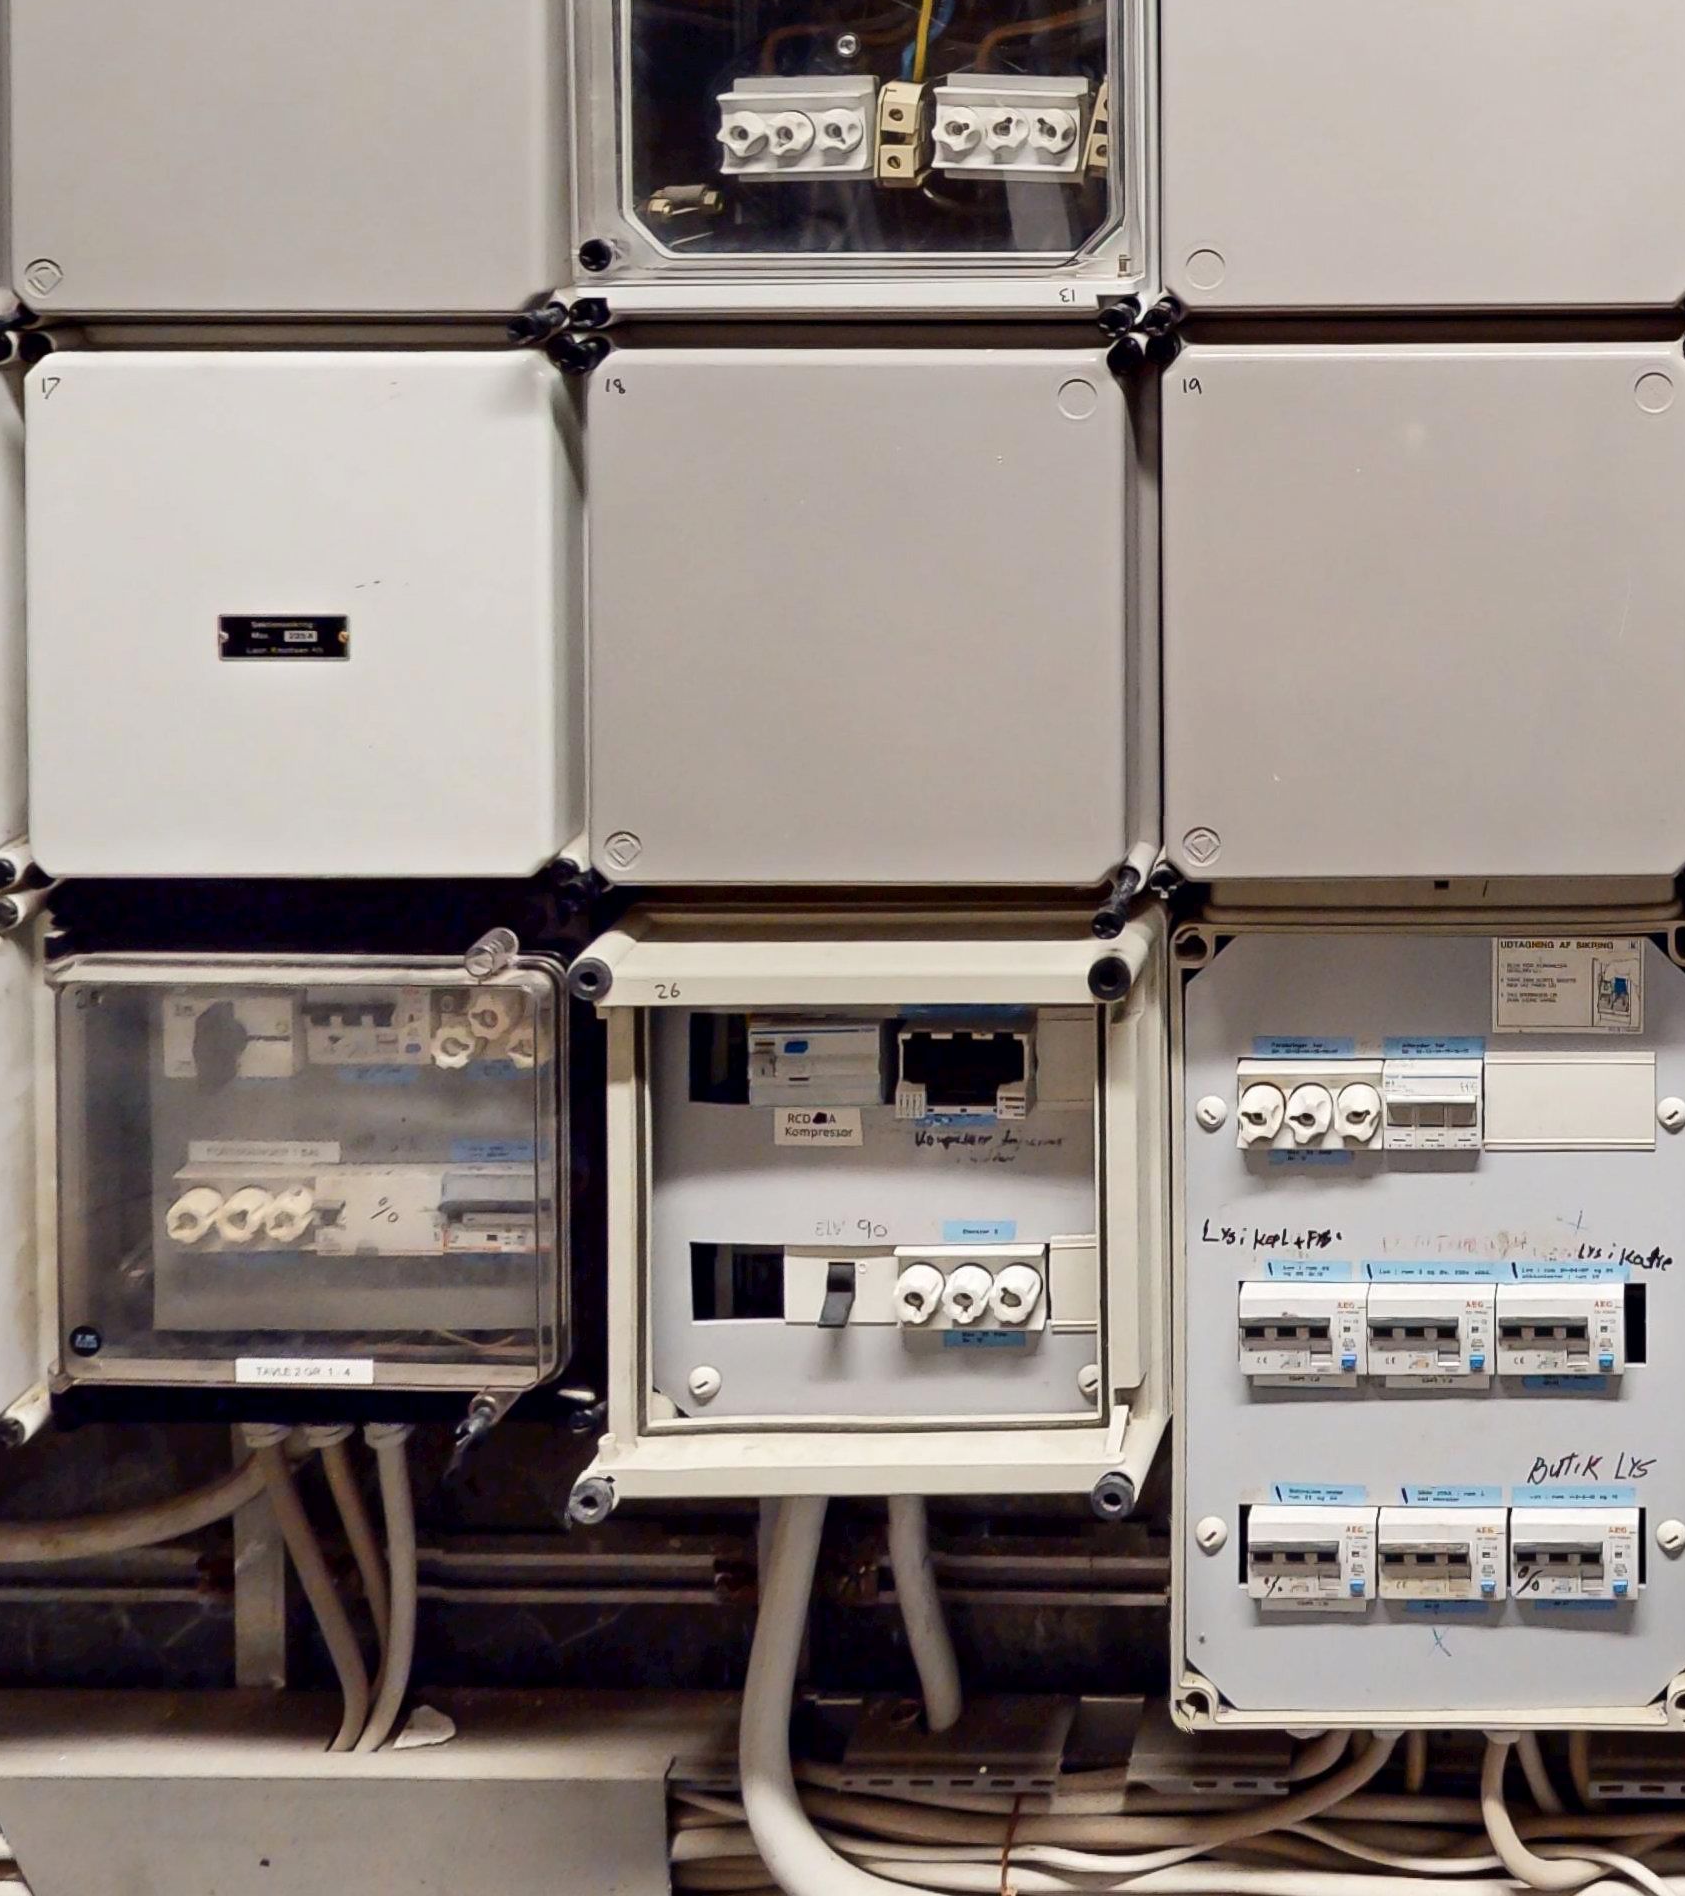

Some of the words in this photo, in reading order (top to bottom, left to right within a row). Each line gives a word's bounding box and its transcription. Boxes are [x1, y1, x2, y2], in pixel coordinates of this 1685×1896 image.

[40, 376, 61, 399] 17
[1181, 376, 1203, 395] 19
[1558, 941, 1572, 950] AF
[654, 983, 681, 1000] 26
[787, 1113, 812, 1125] RCD
[784, 1127, 854, 1140] Kompressor
[1526, 1455, 1603, 1485] BUTIK
[1614, 1452, 1656, 1480] LYS
